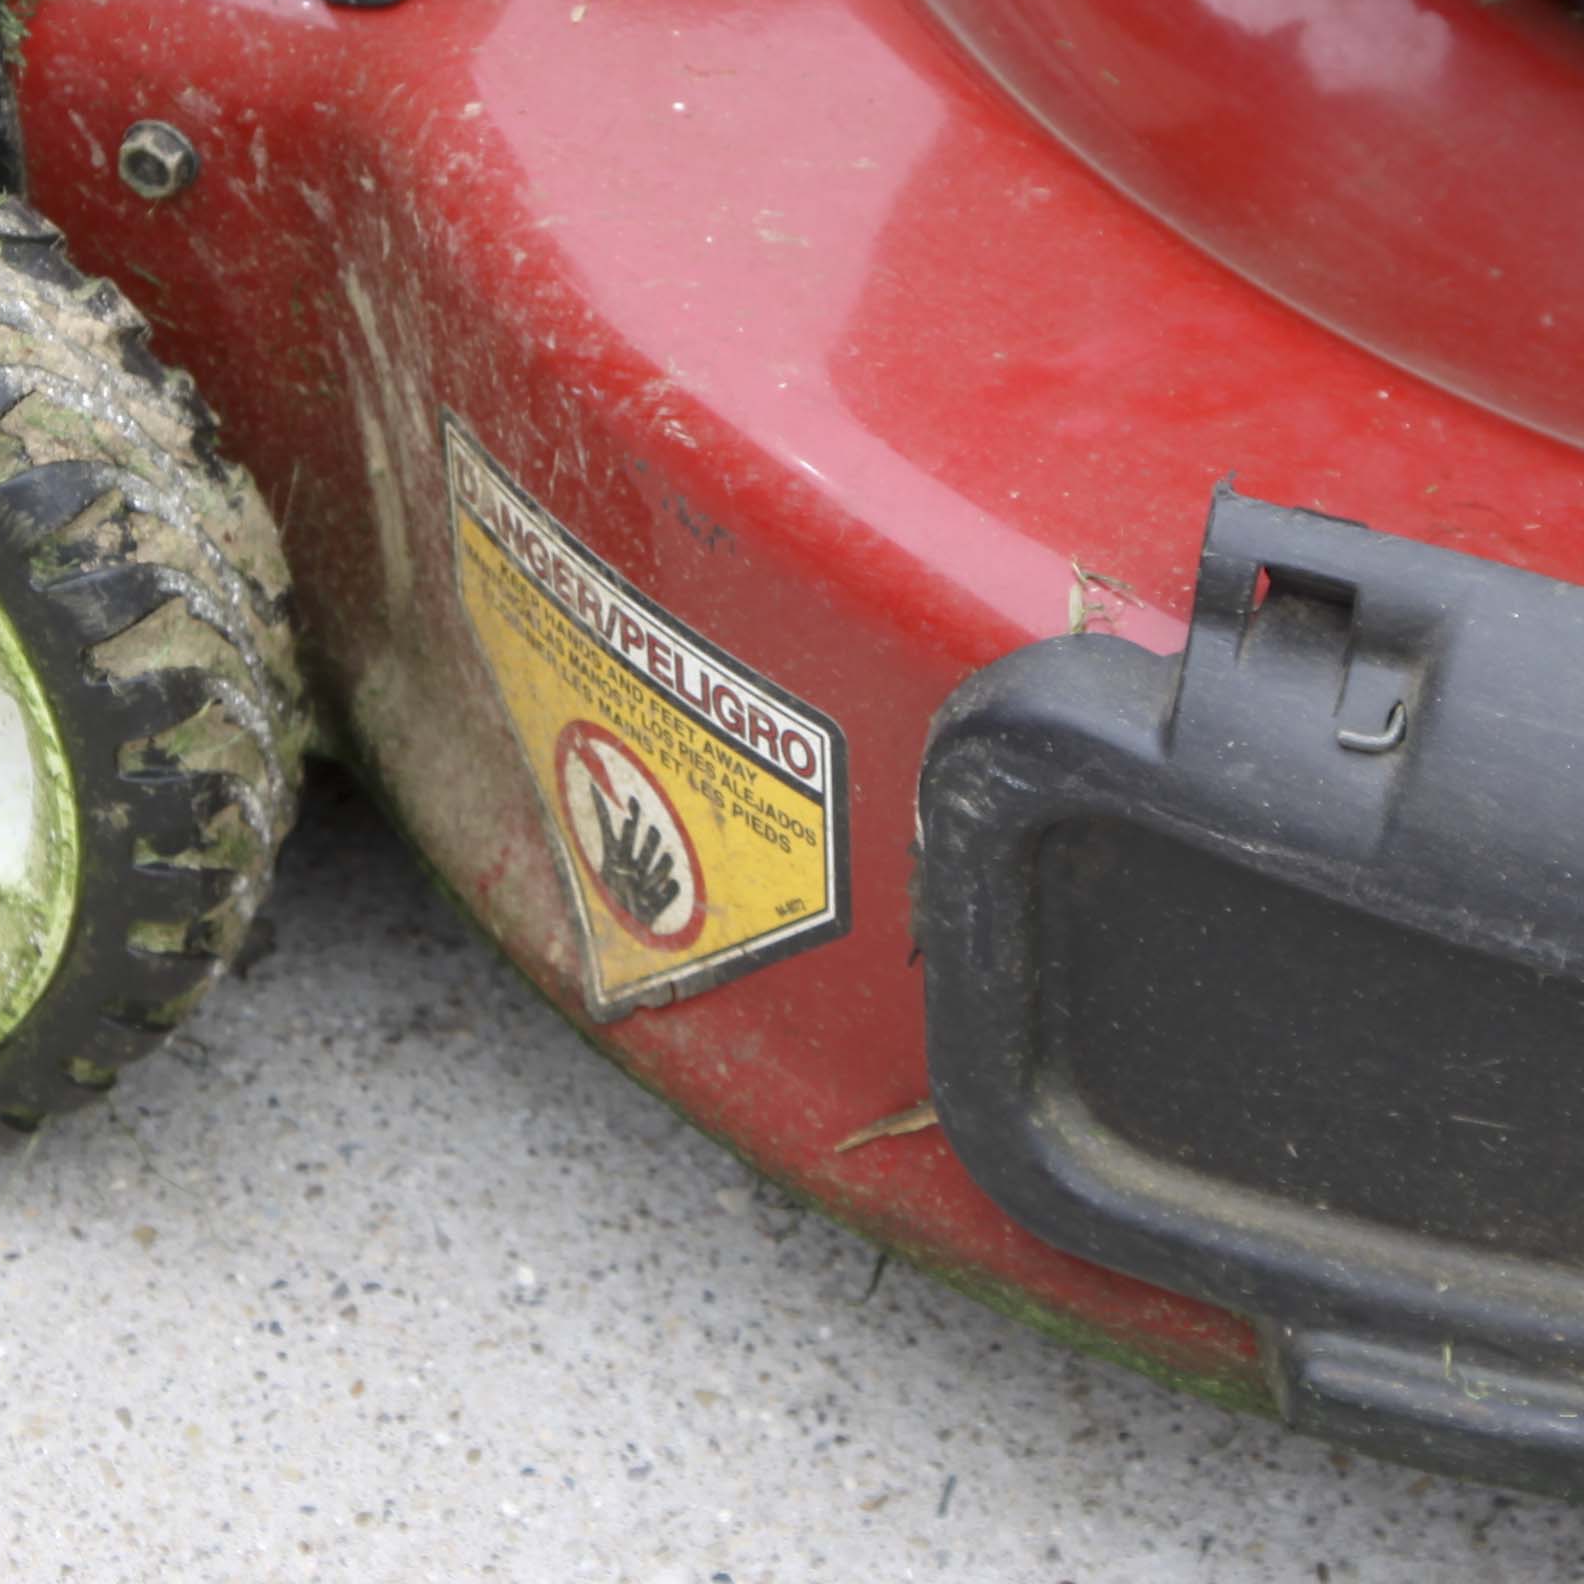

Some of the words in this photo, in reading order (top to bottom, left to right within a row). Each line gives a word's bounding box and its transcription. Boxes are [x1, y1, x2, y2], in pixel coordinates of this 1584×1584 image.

[544, 606, 603, 671] HANDS
[607, 665, 645, 704] AND
[649, 695, 697, 743] FEET
[702, 738, 758, 784] AWAY
[568, 650, 624, 709] MANOS
[627, 699, 638, 716] Y
[641, 711, 675, 750] LOS
[679, 742, 717, 781] PIES
[720, 771, 818, 848] ALEJADOS
[659, 750, 682, 776] ET
[688, 776, 726, 810] LES
[731, 803, 793, 855] PIEDS
